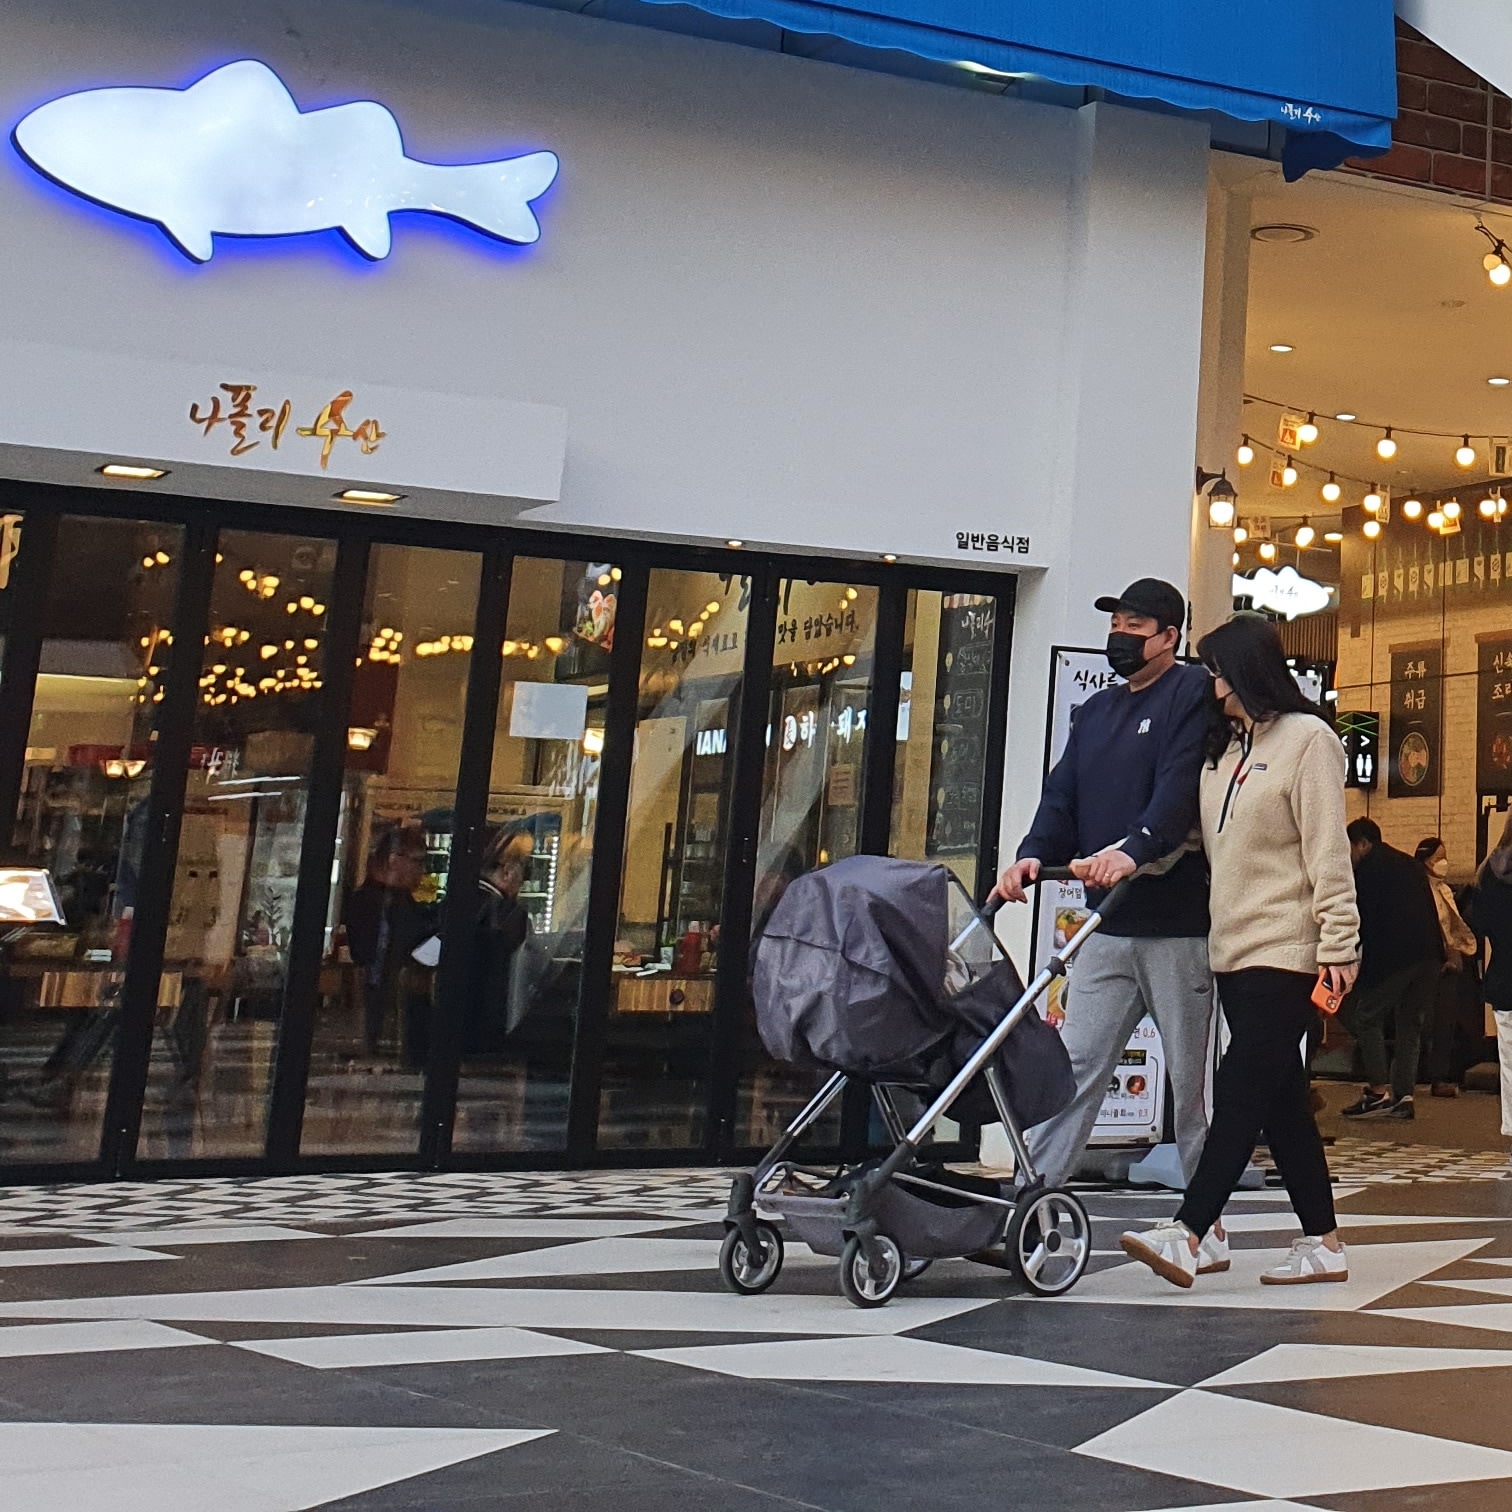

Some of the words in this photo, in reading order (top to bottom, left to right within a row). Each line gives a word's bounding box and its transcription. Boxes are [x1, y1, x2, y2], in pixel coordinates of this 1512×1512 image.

[190, 383, 291, 456] 나폴리
[296, 390, 386, 469] 수산
[955, 531, 1031, 554] 일반음식점
[1404, 660, 1427, 679] 주류
[1404, 689, 1427, 710] 취급
